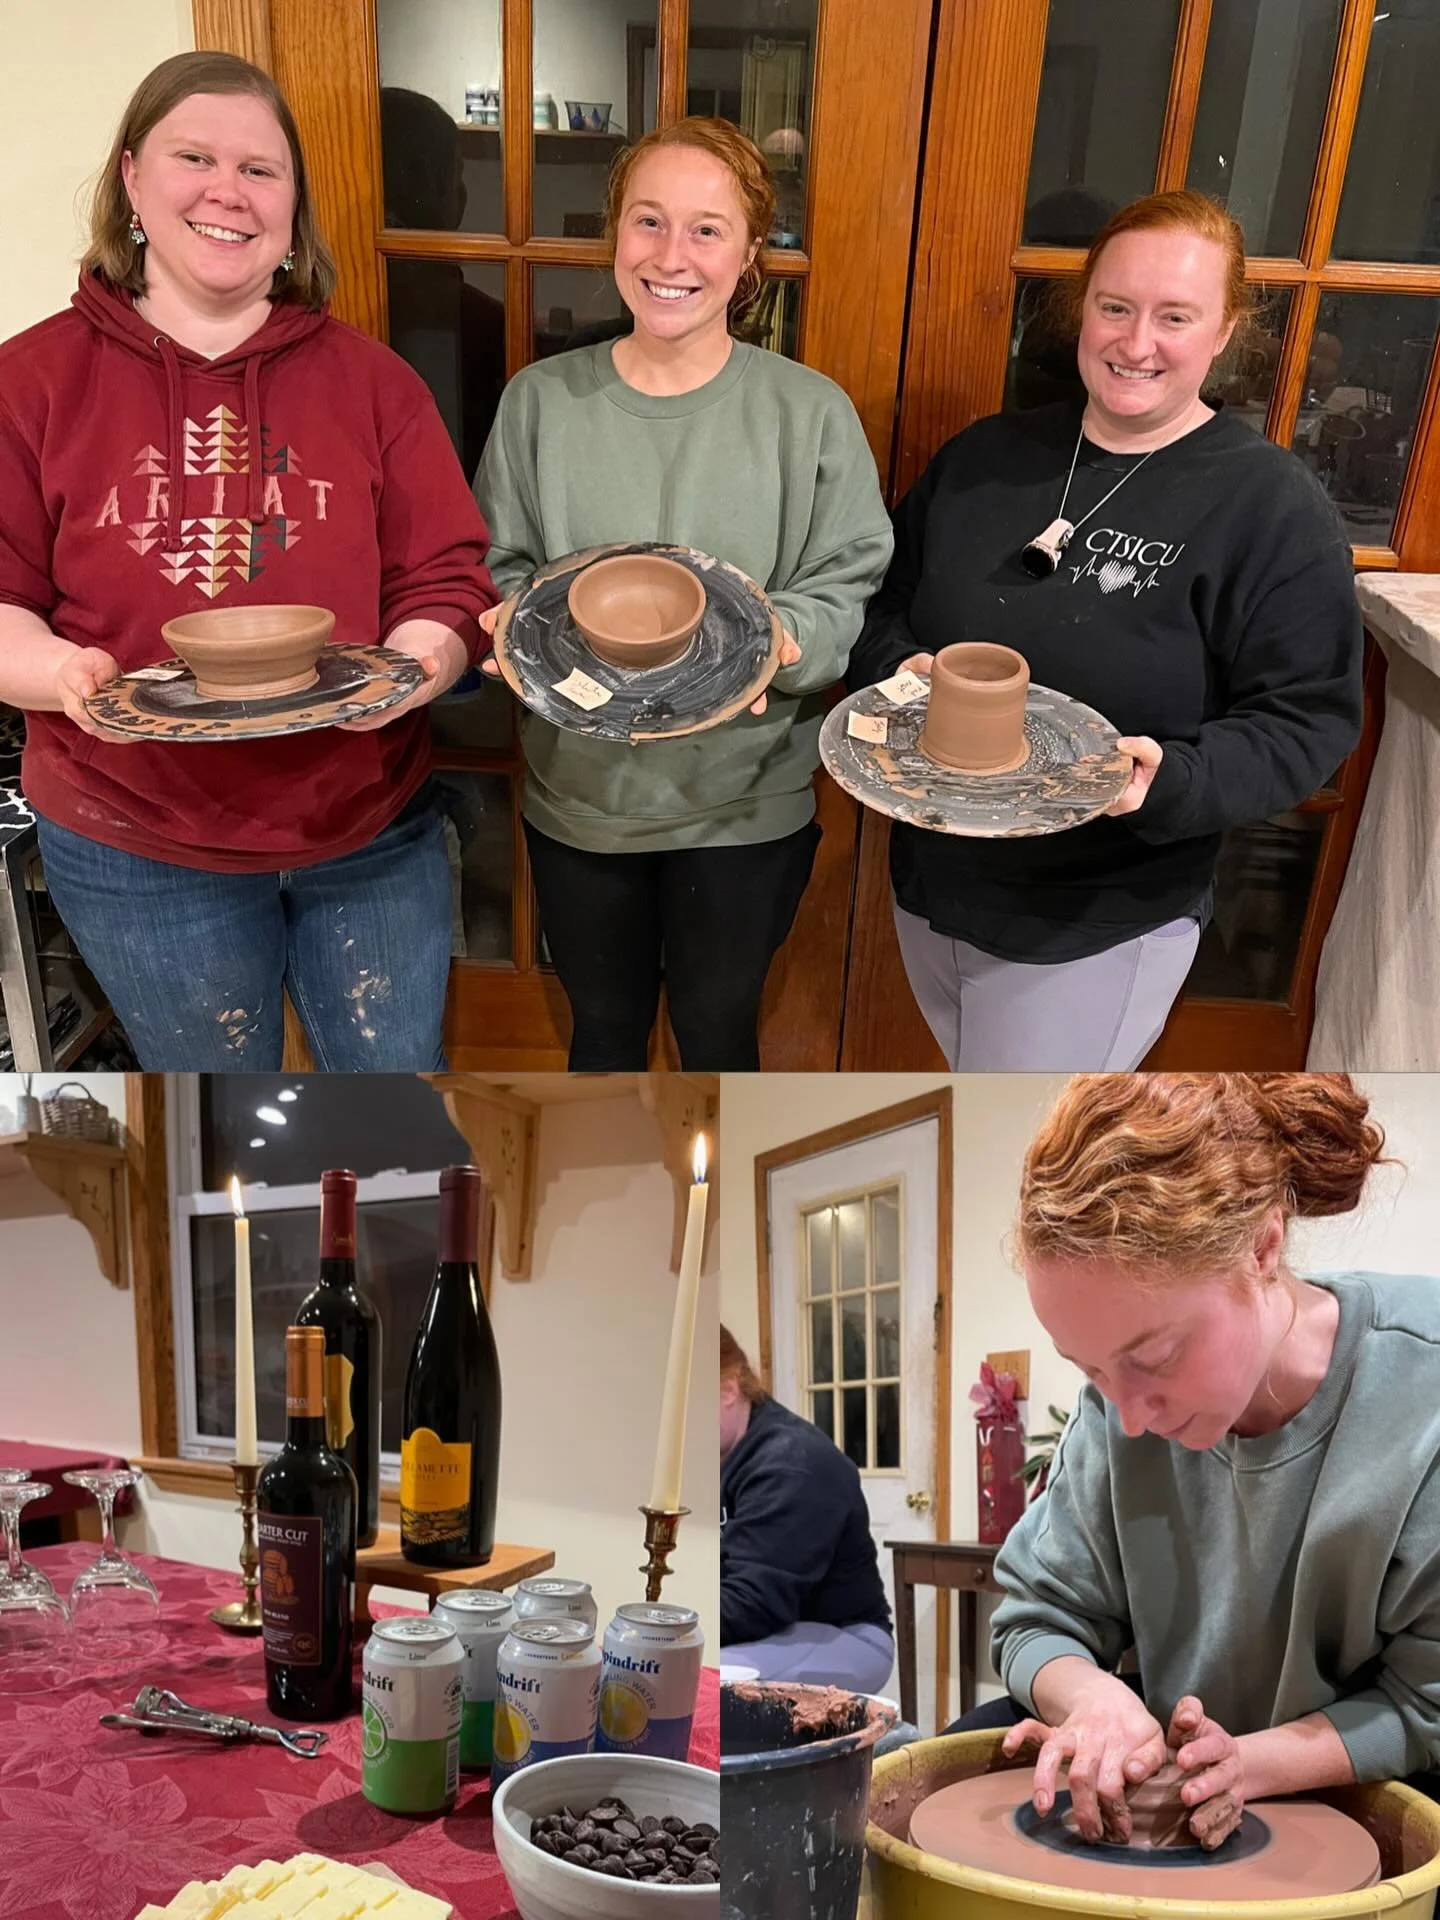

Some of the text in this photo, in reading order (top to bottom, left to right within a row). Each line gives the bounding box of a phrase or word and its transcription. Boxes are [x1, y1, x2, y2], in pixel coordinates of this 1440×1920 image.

[95, 475, 334, 528] ARIAT
[1085, 528, 1186, 567] CTSICU
[285, 1529, 309, 1542] CUT
[602, 1650, 661, 1674] pindrift
[514, 1700, 540, 1731] WATER
